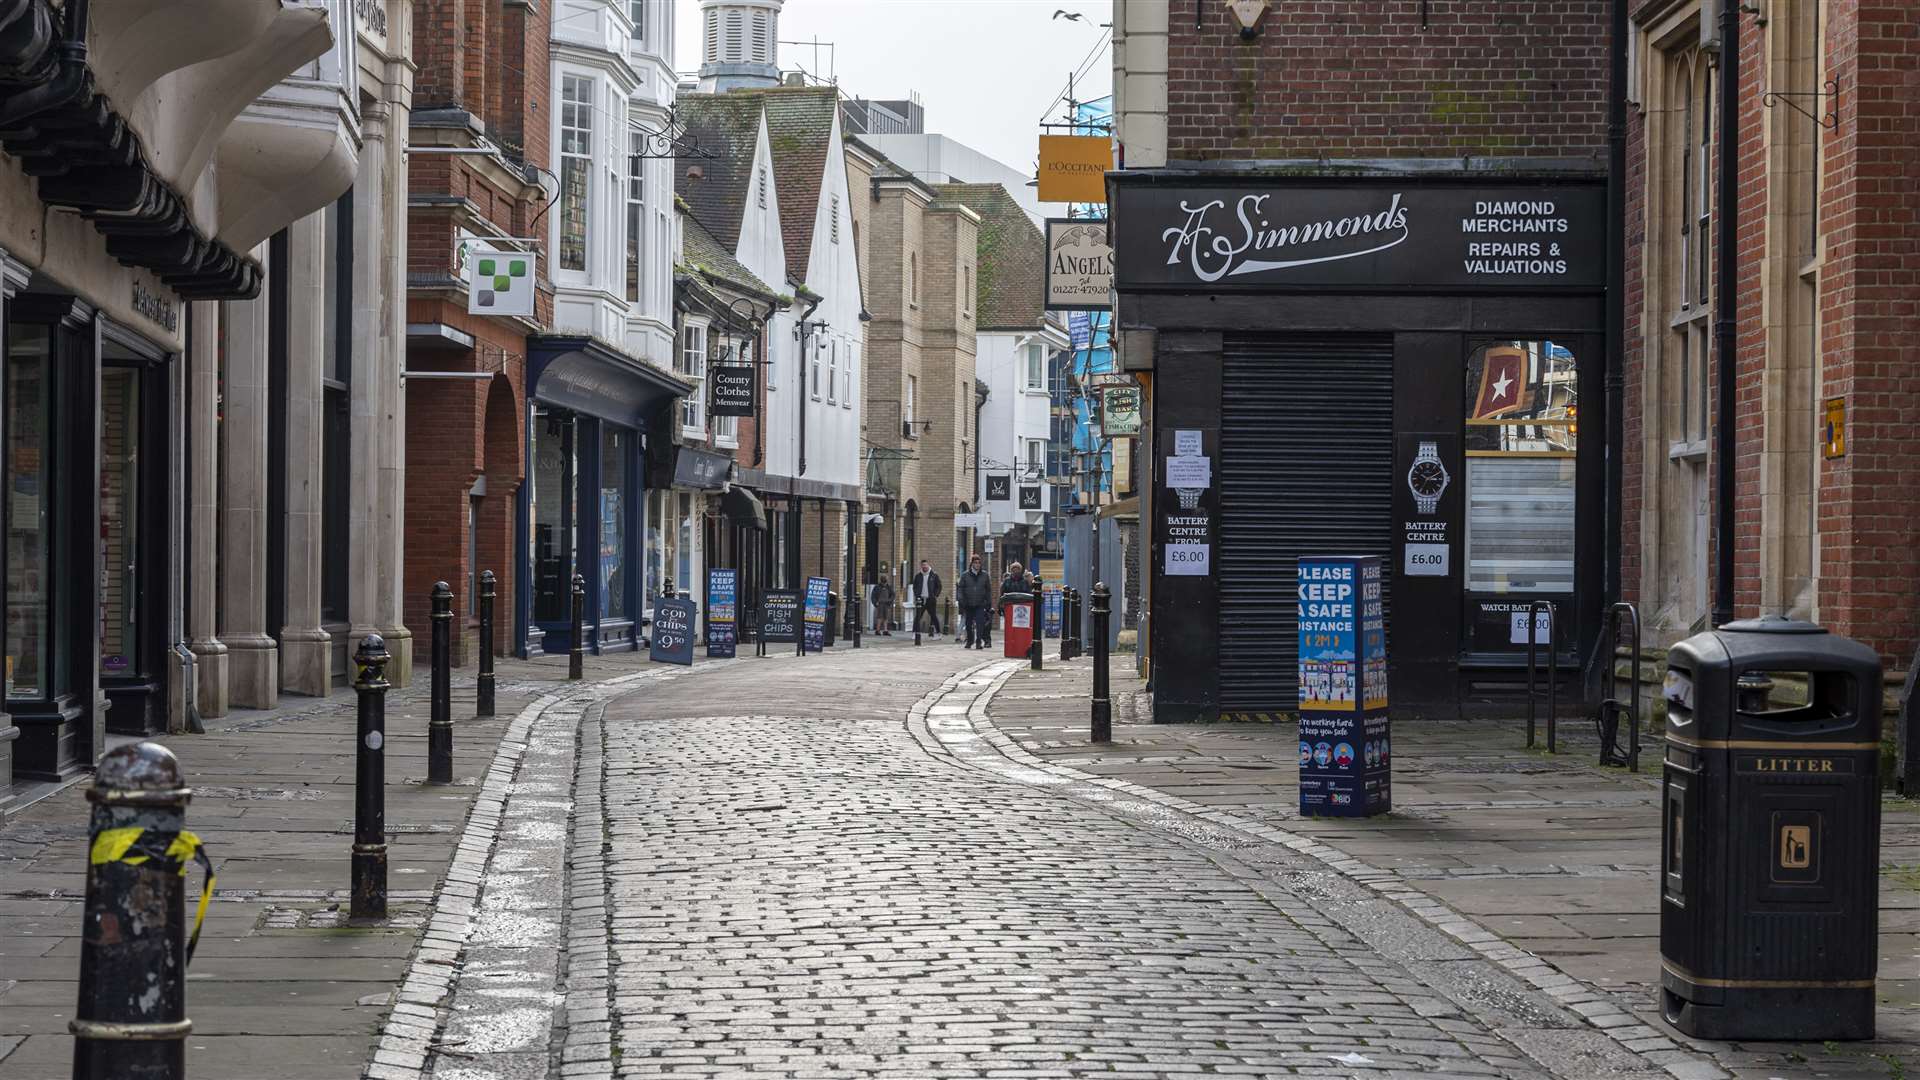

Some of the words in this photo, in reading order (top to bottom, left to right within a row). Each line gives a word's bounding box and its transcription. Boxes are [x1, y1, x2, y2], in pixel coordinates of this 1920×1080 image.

[1475, 201, 1555, 215] DIAMOND
[1213, 193, 1408, 258] Simmonds
[1462, 218, 1568, 232] MERCHANTS
[1469, 242, 1541, 256] REPAIRS
[1549, 242, 1561, 256] &
[1052, 250, 1114, 275] ANGELS
[1464, 260, 1567, 273] VALUATIONS
[716, 374, 751, 387] County
[715, 385, 751, 396] Clothes
[715, 398, 751, 407] Menswear
[1168, 516, 1209, 525] BATTERY
[1405, 521, 1447, 530] BATTERY
[1169, 527, 1208, 536] CENTRE
[1407, 532, 1445, 541] CENTRE
[1172, 551, 1204, 562] £6.00
[1411, 554, 1443, 565] £6.00
[711, 577, 735, 585] KEEP
[808, 584, 828, 592] KEEP
[1362, 582, 1381, 601] KEEP
[1308, 604, 1353, 618] SAFE
[1481, 603, 1510, 612] WATCH
[767, 610, 792, 618] FISH
[656, 620, 688, 631] CHIPS
[764, 623, 793, 633] CHIPS
[1311, 718, 1336, 728] working
[1305, 727, 1319, 737] keep
[1320, 729, 1333, 737] you
[1756, 759, 1833, 772] LITTER
